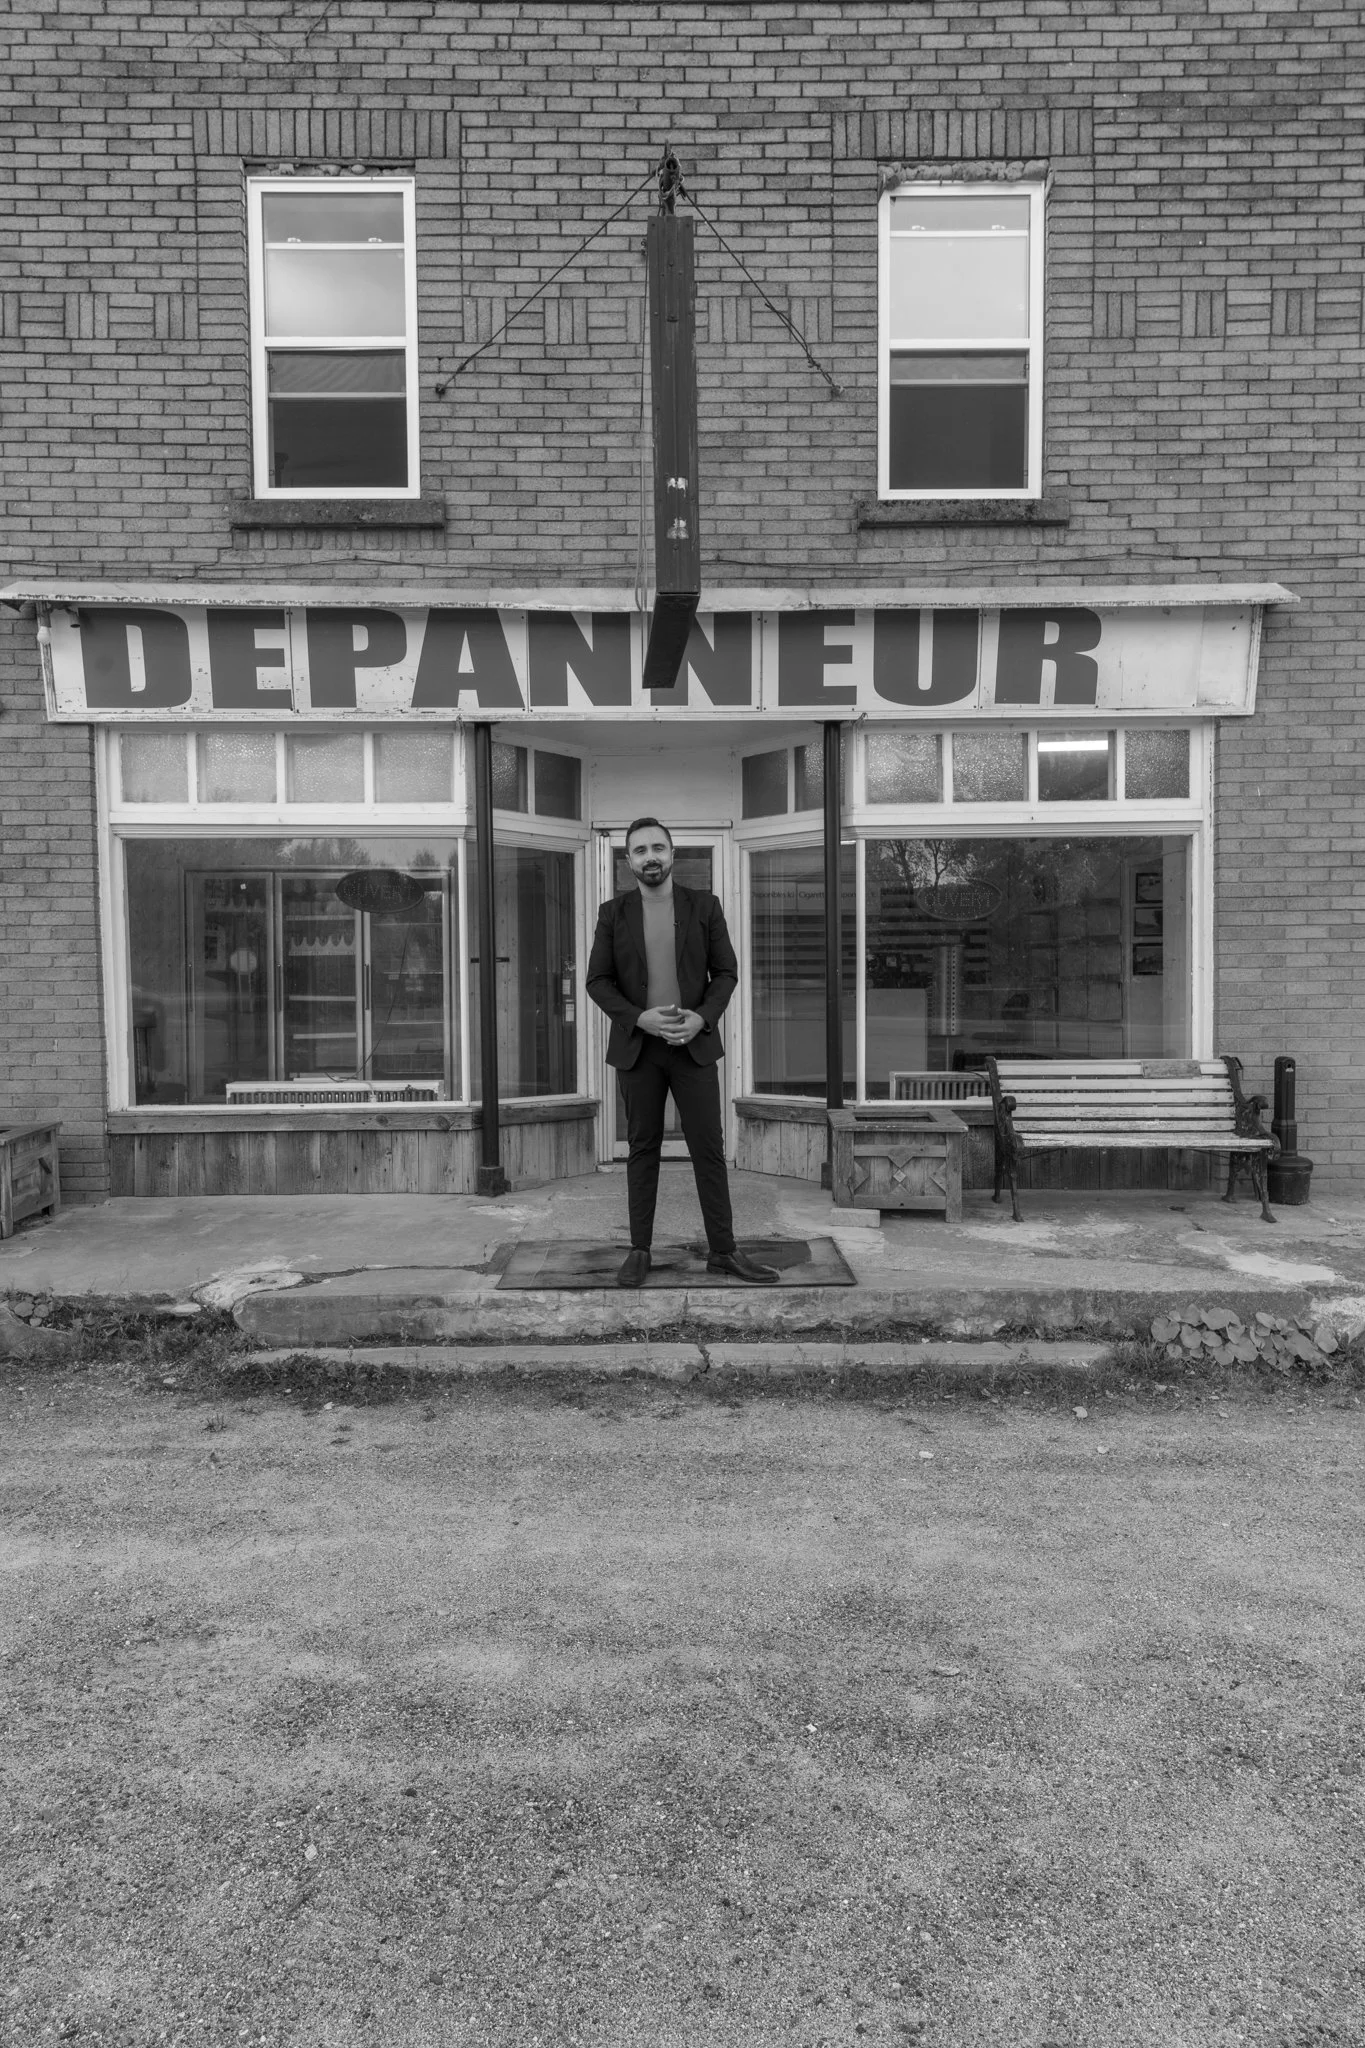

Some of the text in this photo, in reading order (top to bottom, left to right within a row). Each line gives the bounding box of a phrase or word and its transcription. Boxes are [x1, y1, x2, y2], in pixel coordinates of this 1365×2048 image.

[78, 606, 1103, 710] DEPANNEUR
[343, 882, 415, 903] OUVERT
[924, 892, 993, 908] OUVERT
